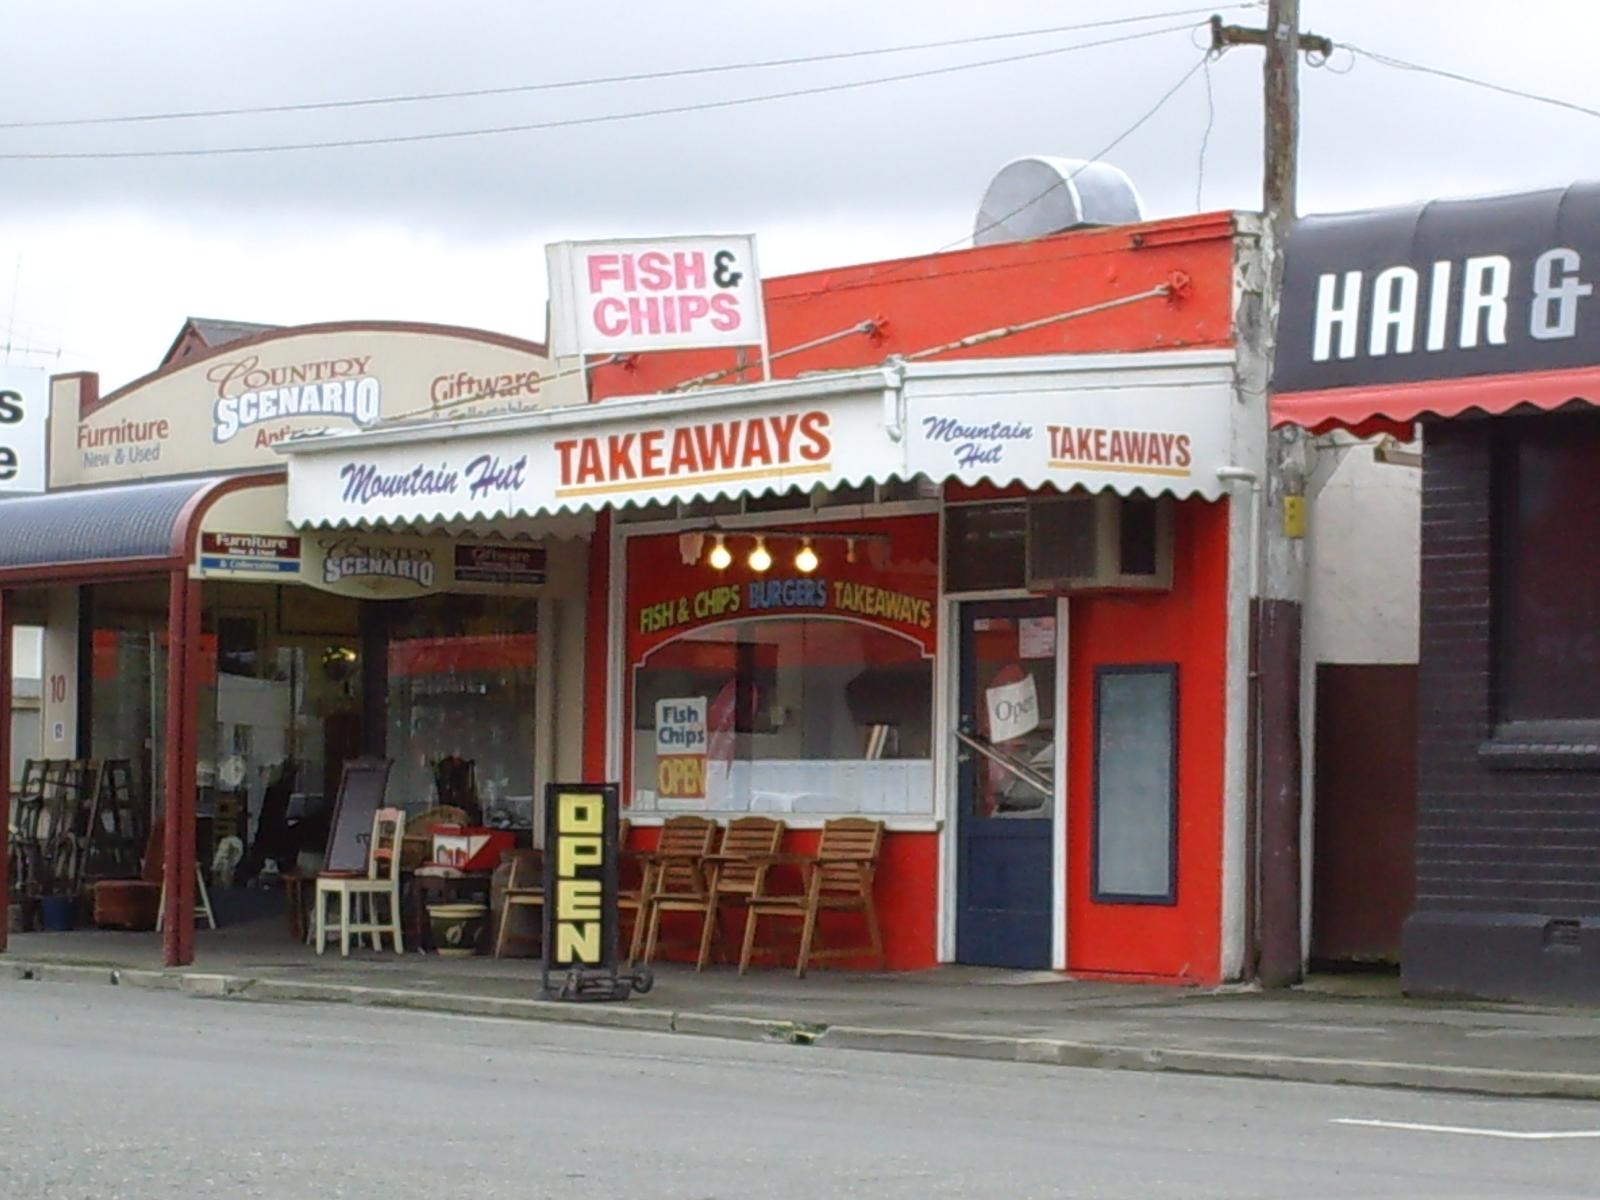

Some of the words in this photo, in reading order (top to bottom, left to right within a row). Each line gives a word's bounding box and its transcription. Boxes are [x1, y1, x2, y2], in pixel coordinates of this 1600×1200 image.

[587, 252, 707, 293] FISH
[713, 250, 743, 288] &
[593, 293, 741, 337] CHIPS
[1312, 255, 1511, 361] HAIR
[1529, 248, 1593, 340] &
[206, 355, 371, 400] COUNTRY
[431, 370, 540, 404] Giftware
[213, 377, 381, 444] SCENARIO
[77, 418, 169, 449] Furniture
[922, 416, 1033, 443] Mountain
[1047, 425, 1191, 467] TAKEAWAYS
[83, 451, 110, 469] New
[114, 448, 126, 465] &
[129, 442, 161, 464] Used
[340, 462, 459, 505] Mountain
[465, 453, 529, 500] Hut
[554, 410, 833, 486] TAKEAWAYS
[954, 443, 1004, 469] Hut
[216, 532, 289, 549] Furniture
[324, 556, 434, 587] SCENARIO
[639, 601, 676, 635] FISH
[676, 596, 690, 624] &
[694, 584, 741, 619] CHIPS
[748, 579, 827, 609] BURGERS
[834, 581, 931, 629] TAKEAWAYS
[50, 673, 66, 703] 10
[662, 705, 699, 723] Fish
[659, 726, 705, 748] Chips
[557, 793, 604, 964] OPEN
